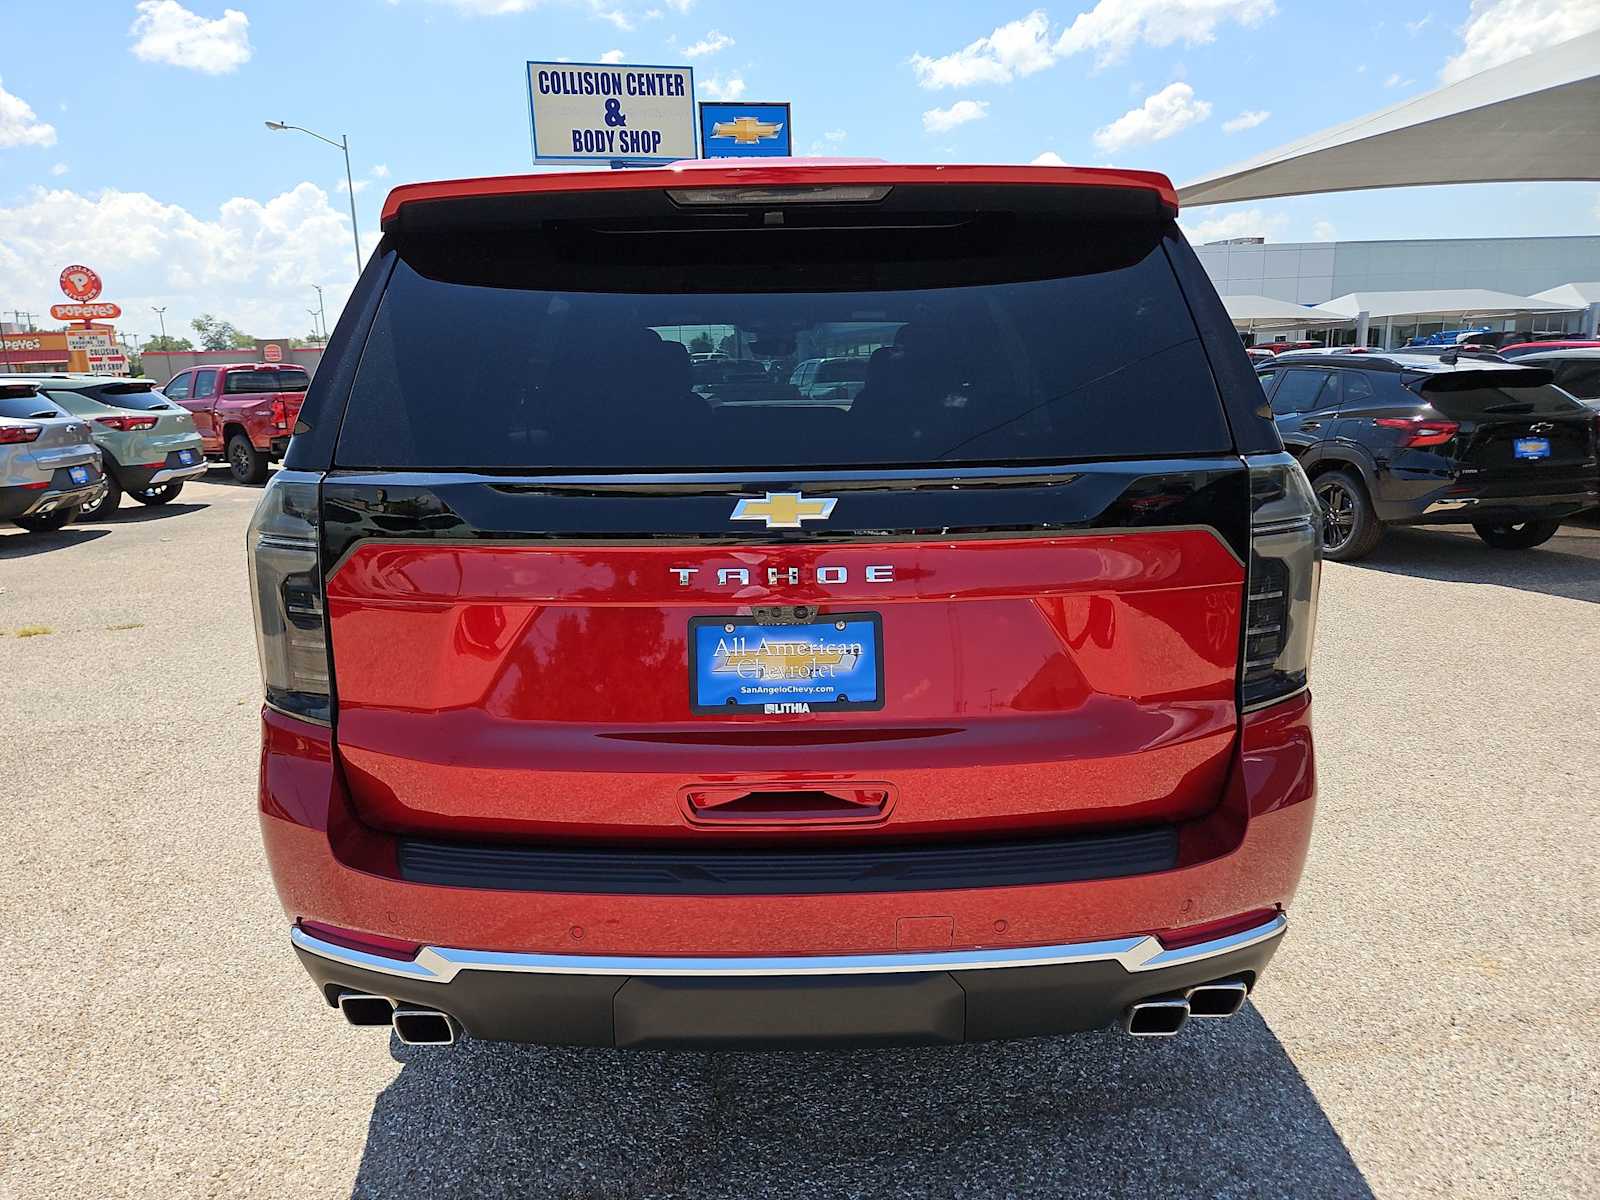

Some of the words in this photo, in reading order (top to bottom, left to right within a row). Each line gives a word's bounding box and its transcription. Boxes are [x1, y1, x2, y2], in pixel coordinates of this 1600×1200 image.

[538, 70, 623, 96] COLLISION
[626, 72, 685, 97] CENTER
[604, 98, 626, 127] &
[572, 129, 615, 153] BODY
[619, 131, 661, 154] SHOP
[669, 565, 895, 586] TAHOE
[712, 637, 747, 657] All
[757, 637, 863, 657] American
[736, 656, 836, 679] Chevrolet
[740, 685, 835, 695] SanAngeloChevy.com
[775, 702, 811, 714] LITHIA
